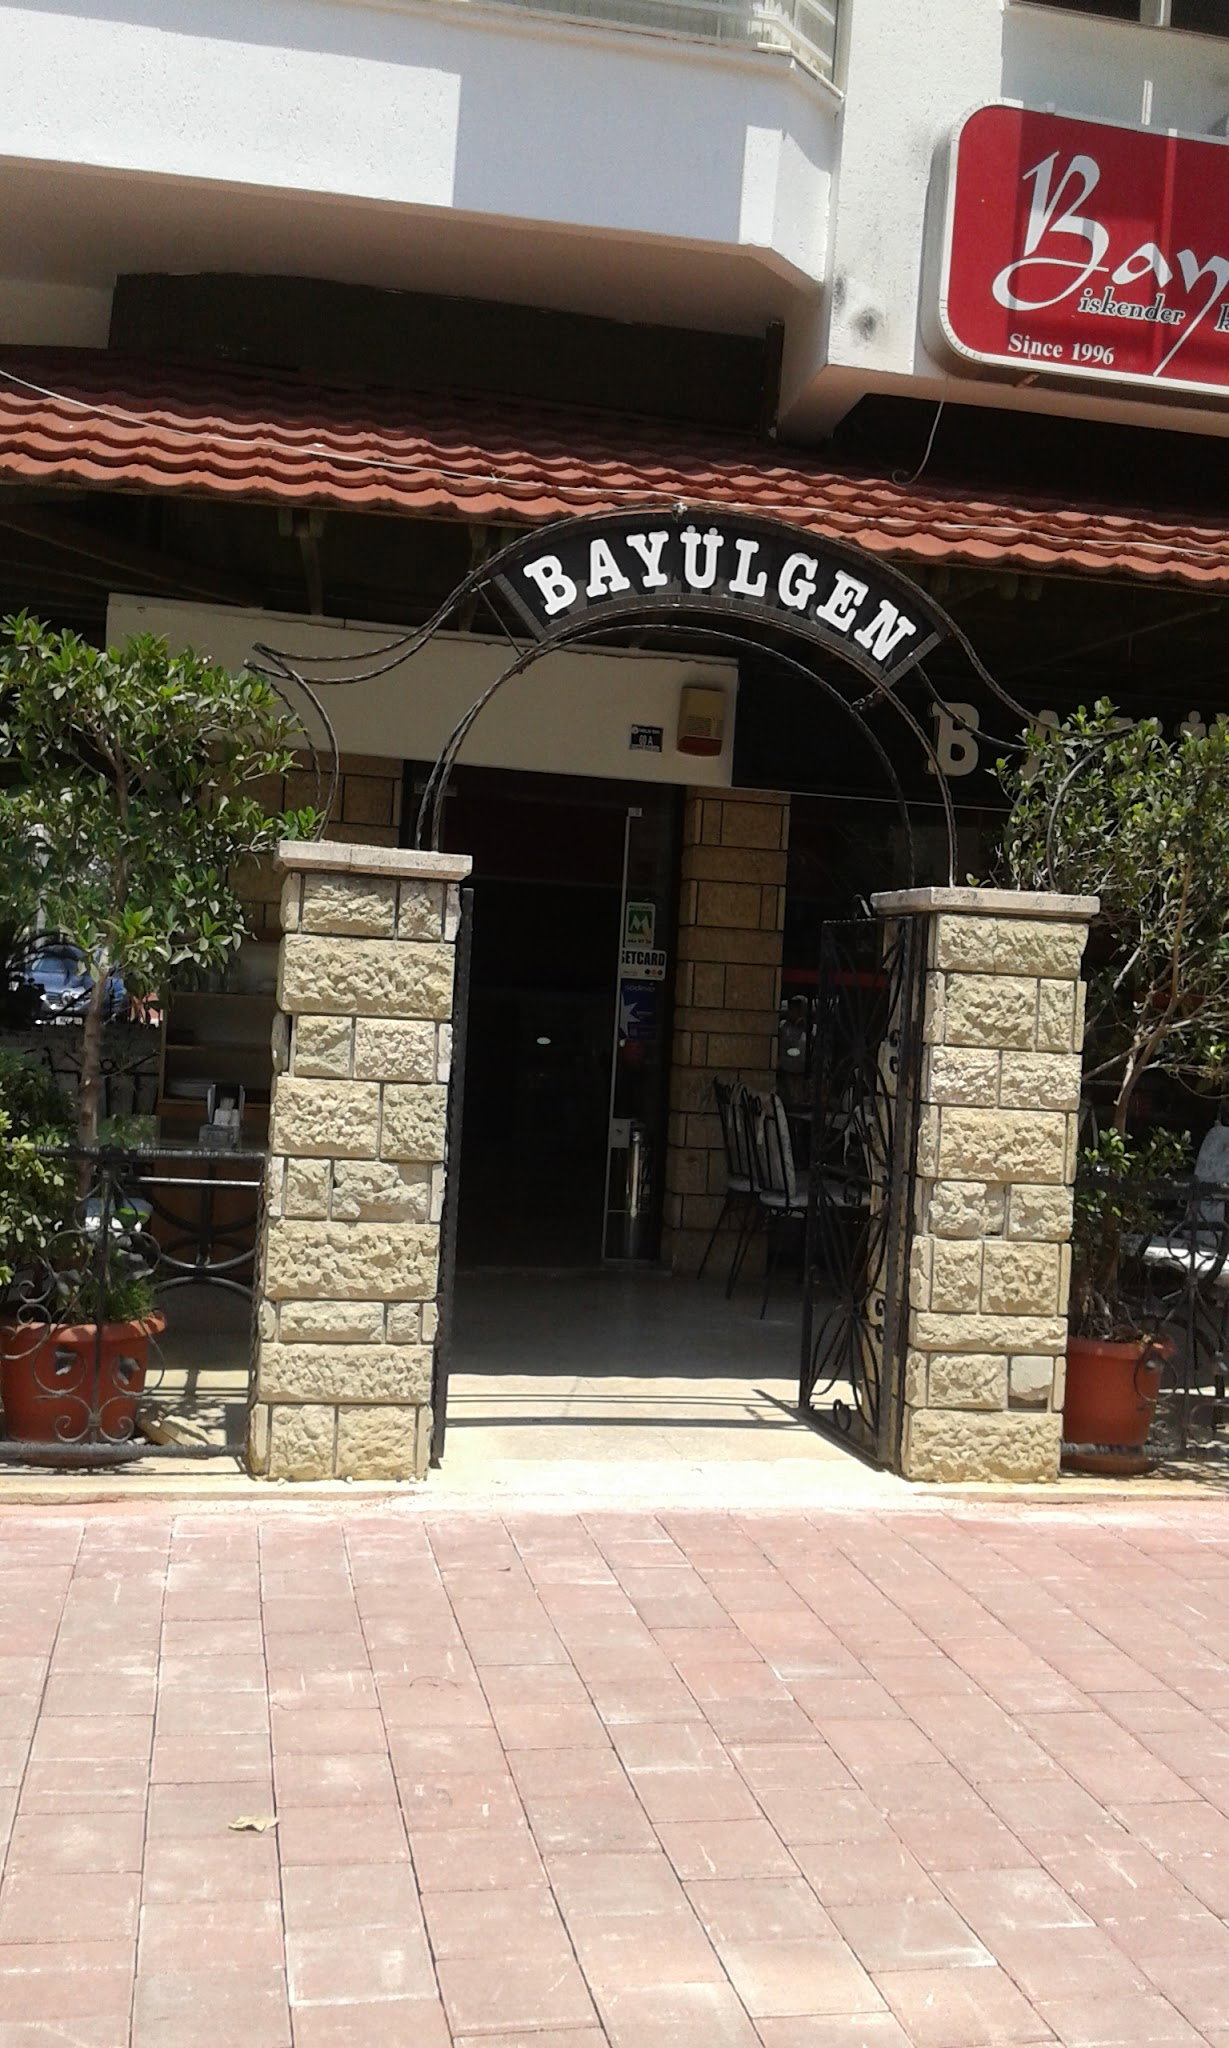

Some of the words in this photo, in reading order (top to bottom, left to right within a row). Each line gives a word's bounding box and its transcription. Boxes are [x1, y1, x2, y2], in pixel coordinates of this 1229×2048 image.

[1077, 286, 1185, 325] iskender
[1008, 333, 1063, 358] Since
[1071, 342, 1115, 365] 1996
[523, 525, 918, 661] BAYÜLGEN
